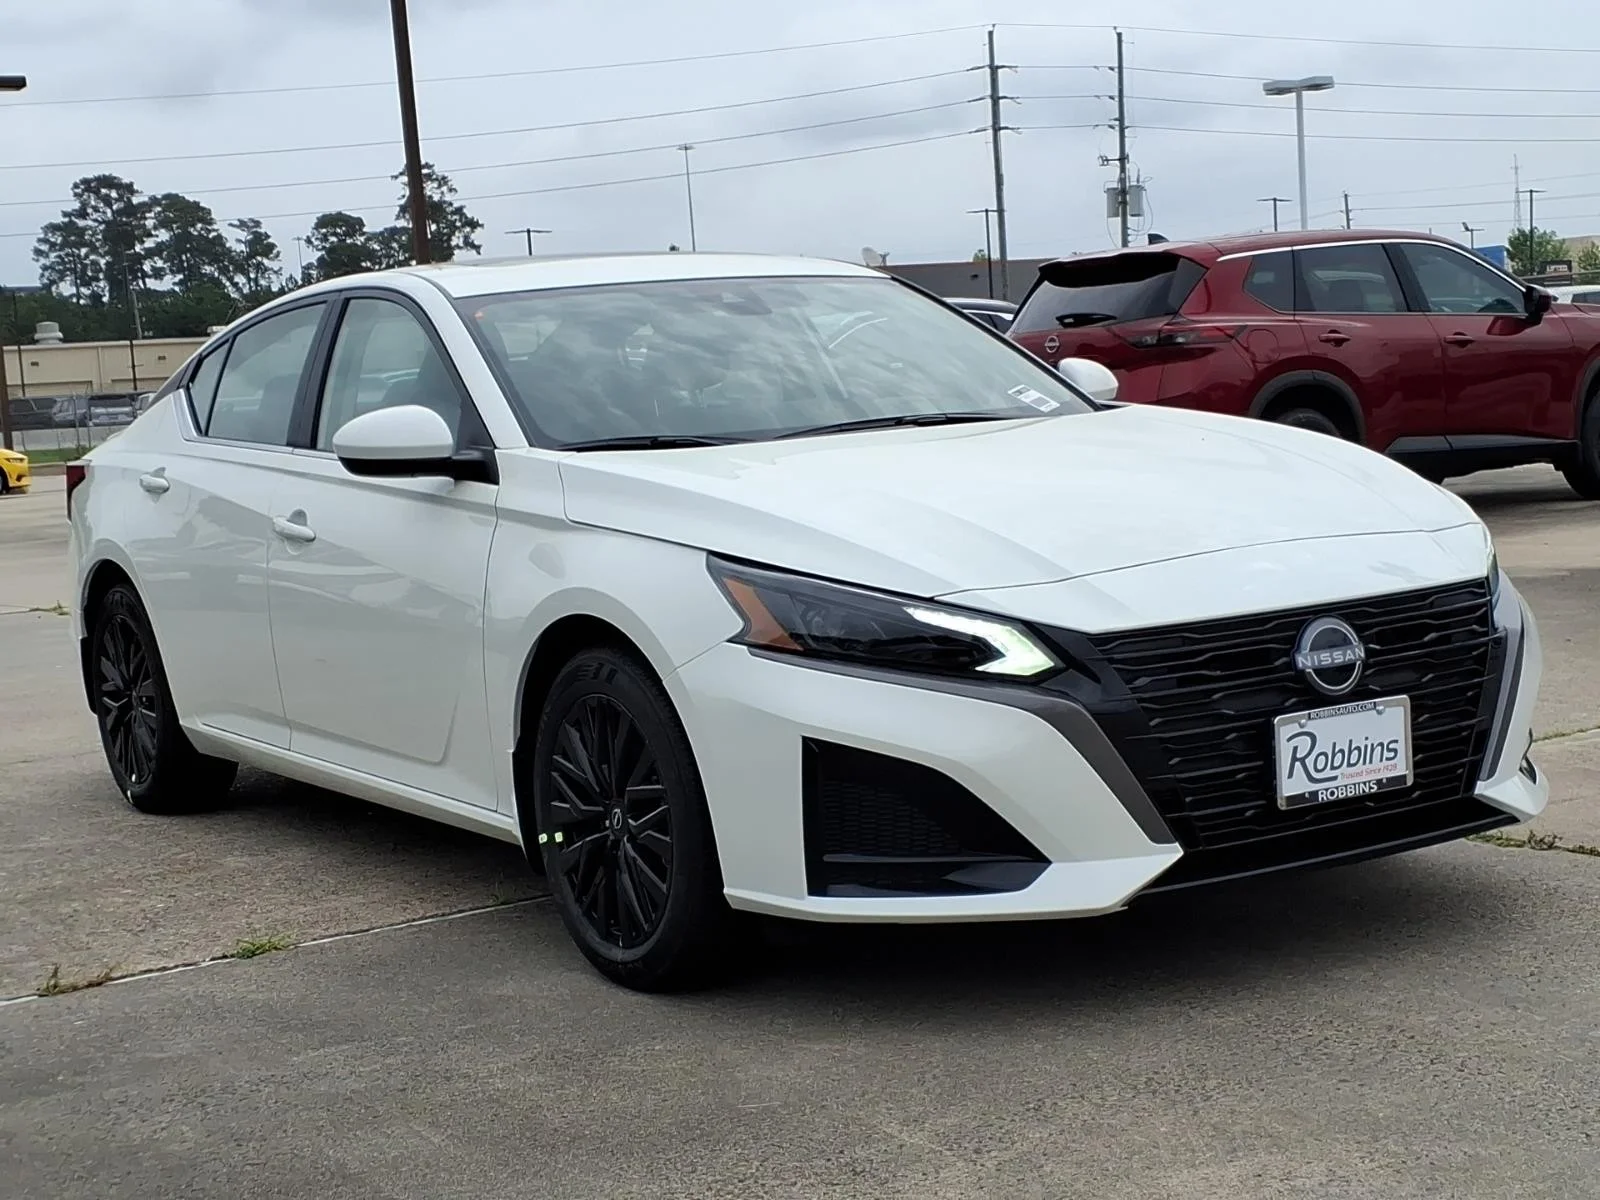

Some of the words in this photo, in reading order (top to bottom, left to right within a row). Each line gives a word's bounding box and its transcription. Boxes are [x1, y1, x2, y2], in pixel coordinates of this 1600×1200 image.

[1297, 646, 1365, 668] NISSAN
[1309, 702, 1376, 720] ROBBINSAUTO.COM
[1286, 730, 1400, 784] Robbins
[1364, 765, 1382, 777] Since
[1318, 779, 1379, 802] ROBBINS
